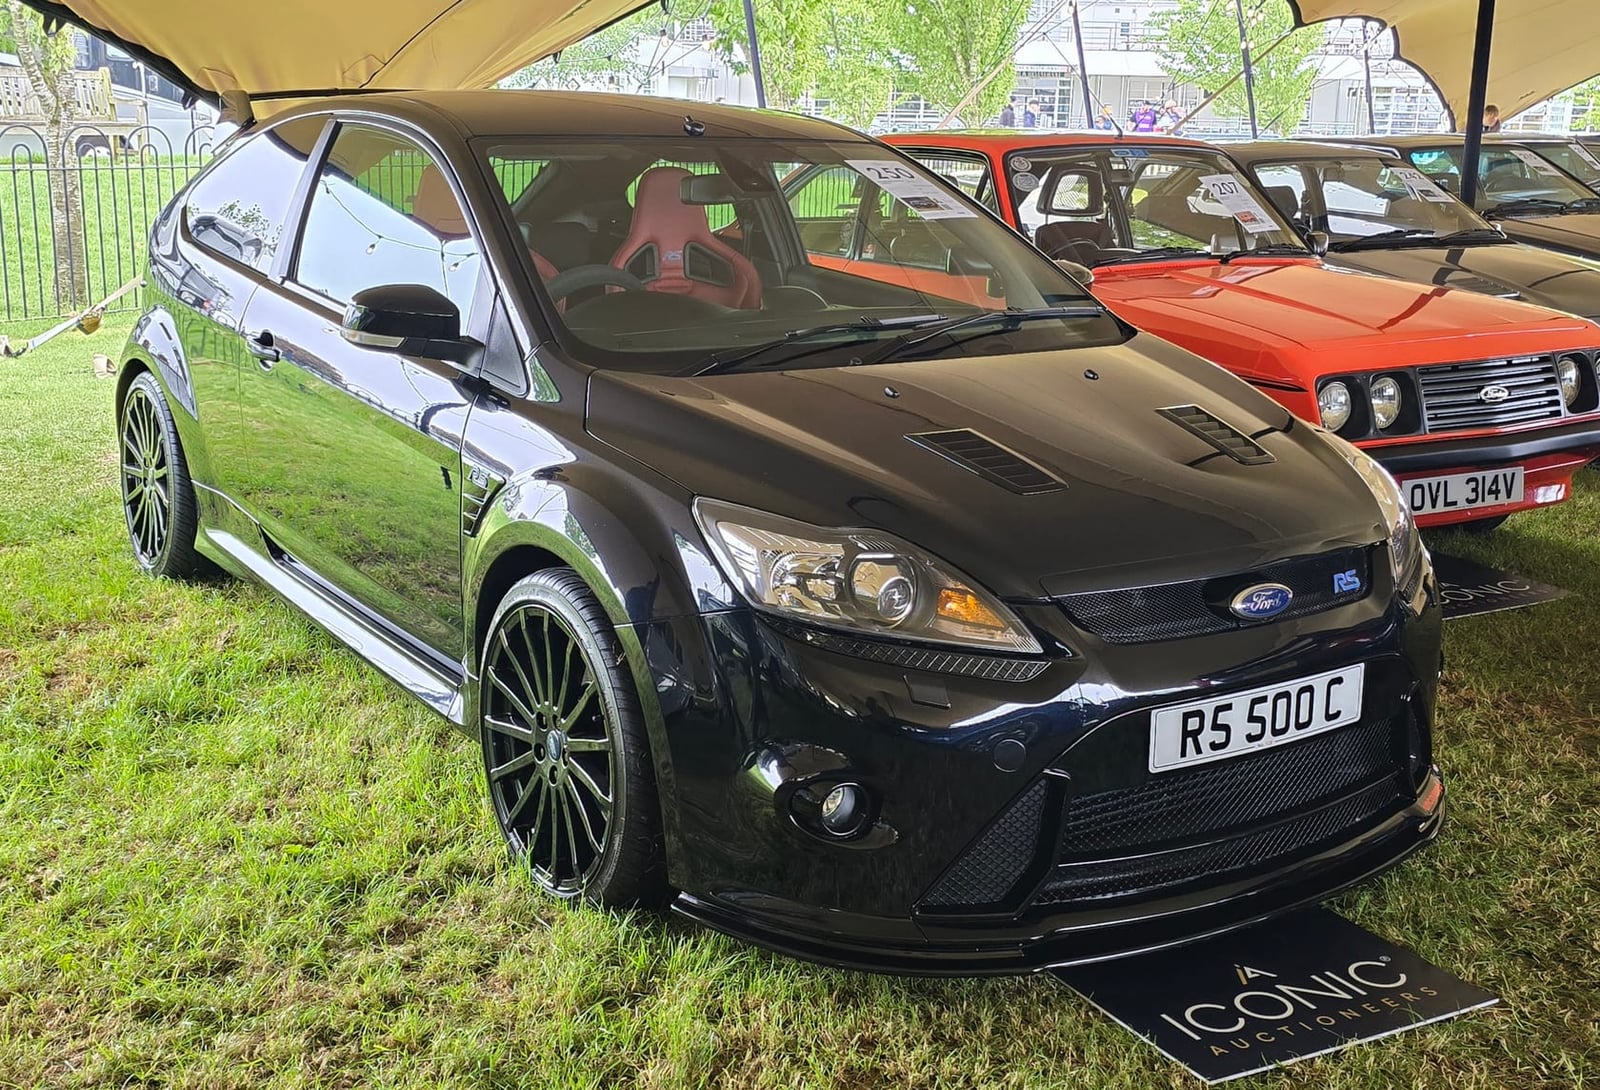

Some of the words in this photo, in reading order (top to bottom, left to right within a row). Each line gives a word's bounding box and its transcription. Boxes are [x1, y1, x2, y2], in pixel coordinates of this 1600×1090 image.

[867, 167, 915, 179] 250
[1212, 181, 1239, 195] 207
[1410, 480, 1458, 511] OVL
[1465, 472, 1516, 504] 314V
[1333, 569, 1360, 594] RS
[1249, 589, 1282, 611] Ford
[1245, 684, 1315, 743] 500
[1324, 676, 1344, 722] C
[1209, 986, 1437, 1056] AUCTIONEERS
